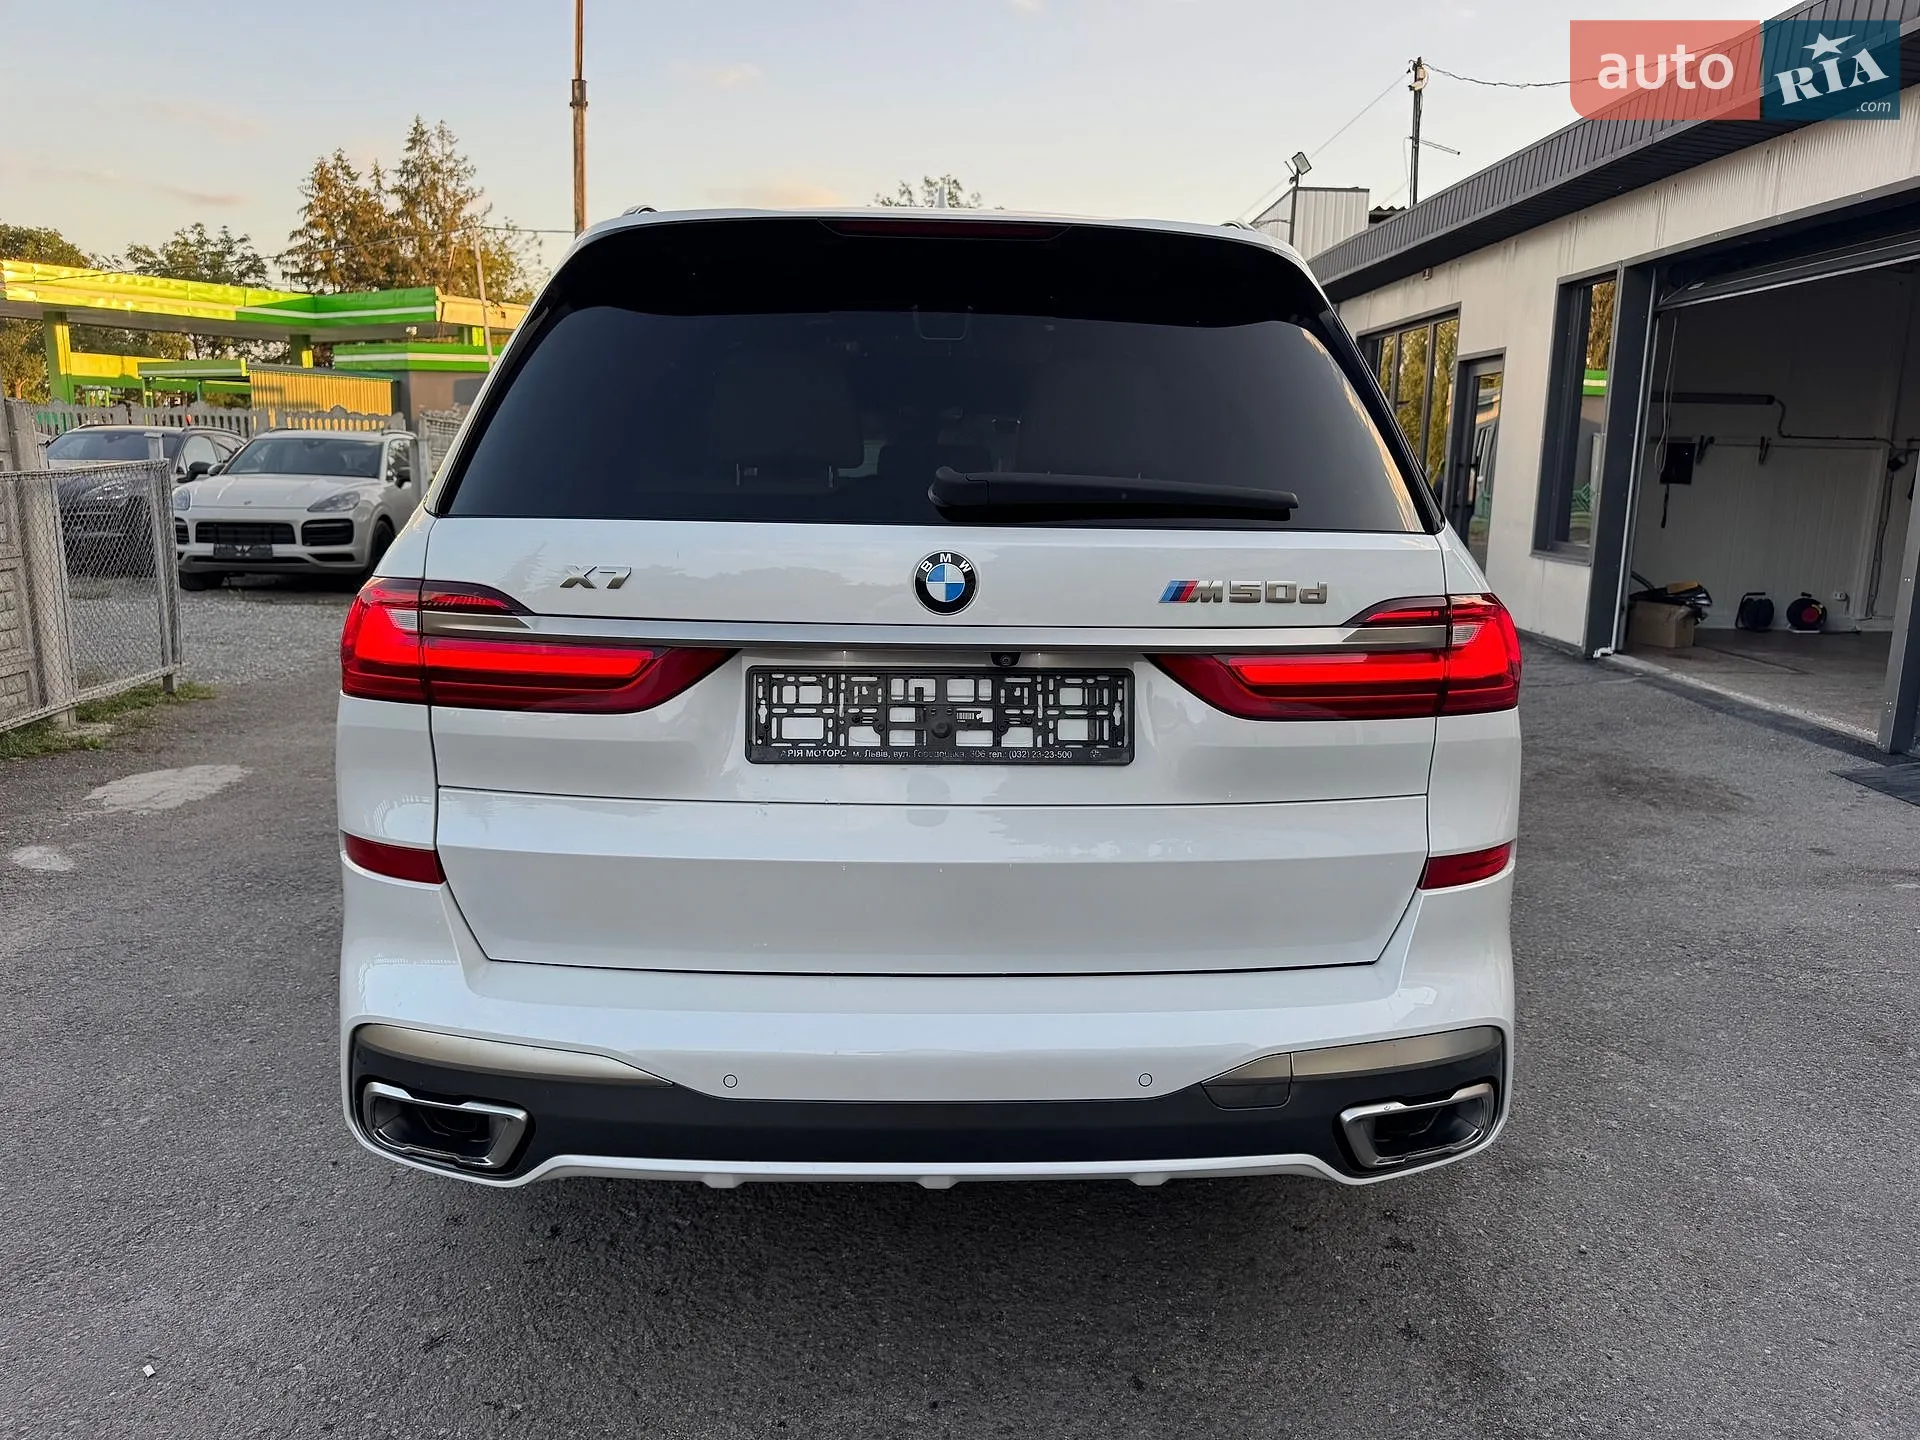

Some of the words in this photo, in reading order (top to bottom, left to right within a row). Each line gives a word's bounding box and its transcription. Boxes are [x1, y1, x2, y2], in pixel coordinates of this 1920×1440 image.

[920, 553, 972, 573] BMW
[560, 565, 632, 589] X7
[1032, 750, 1073, 759] 23-23-500
